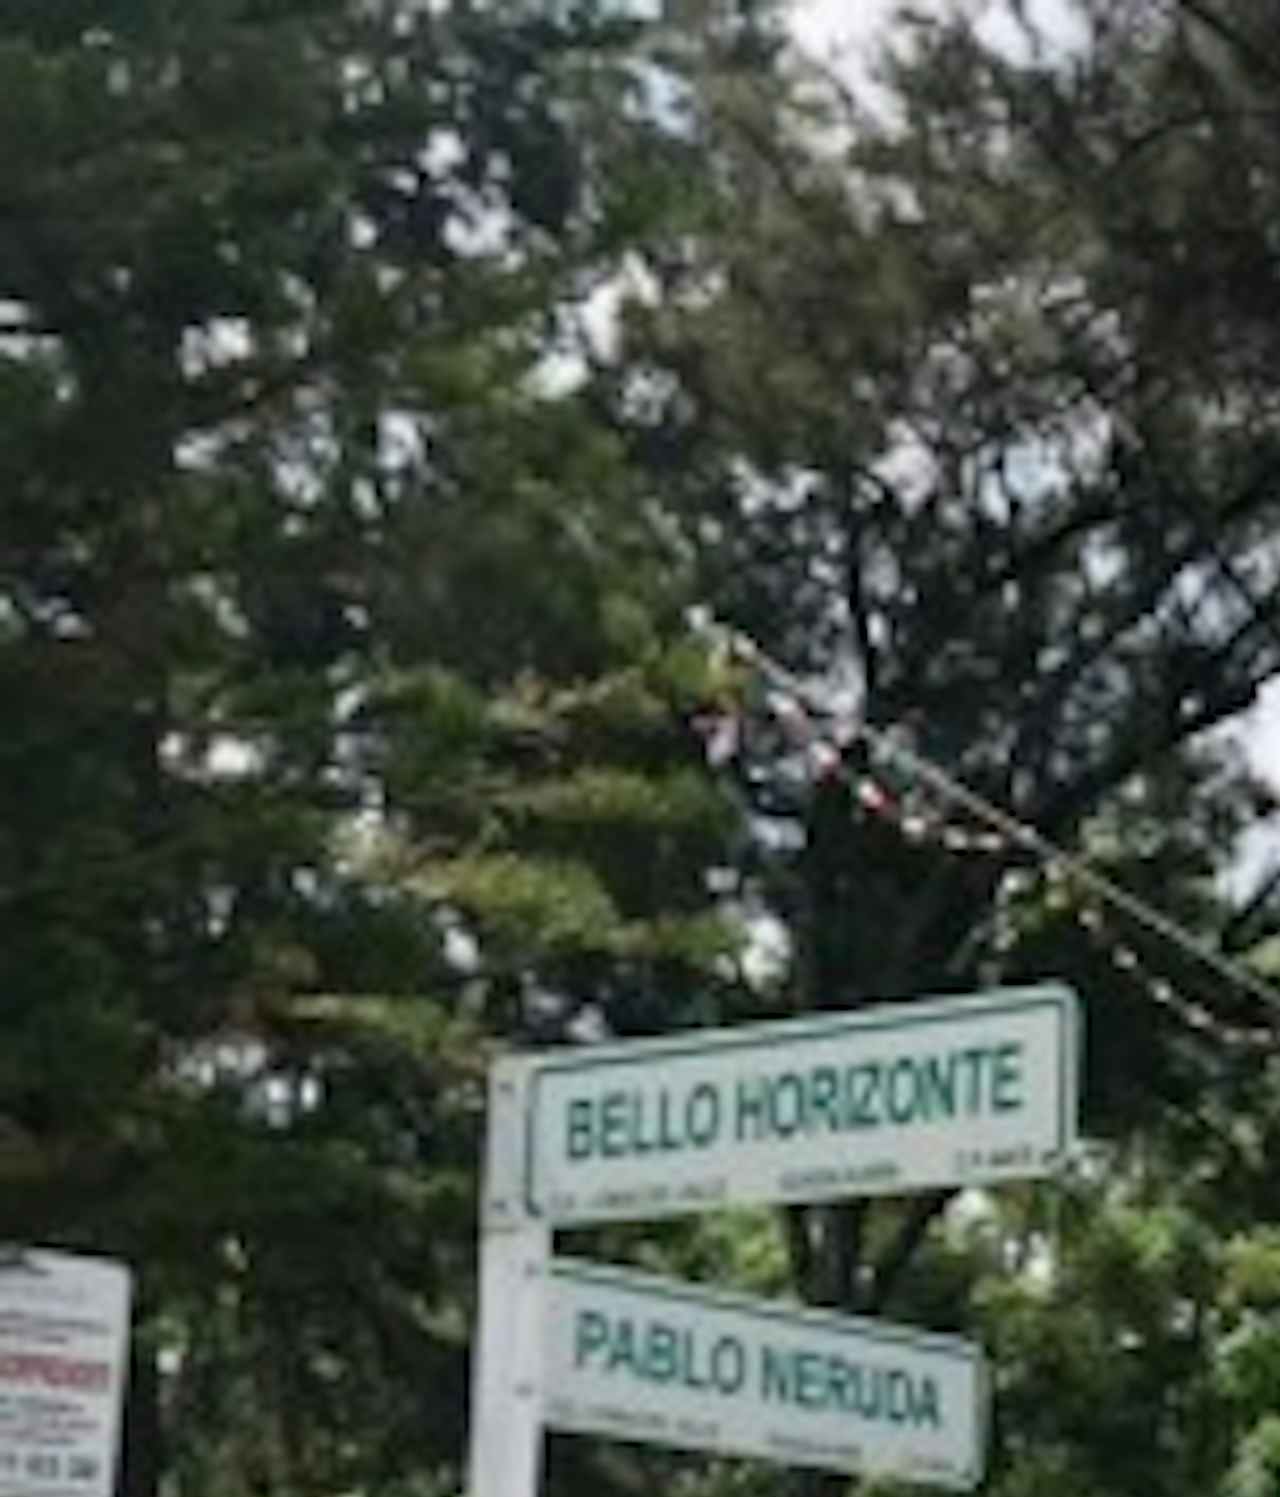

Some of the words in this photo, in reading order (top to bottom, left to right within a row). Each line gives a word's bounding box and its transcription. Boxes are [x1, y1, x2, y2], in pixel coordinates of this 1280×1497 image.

[565, 1083, 719, 1160] BELLO
[735, 1040, 1024, 1141] HORIZONTE
[574, 1309, 748, 1396] PABLO
[760, 1345, 942, 1429] NERUDA
